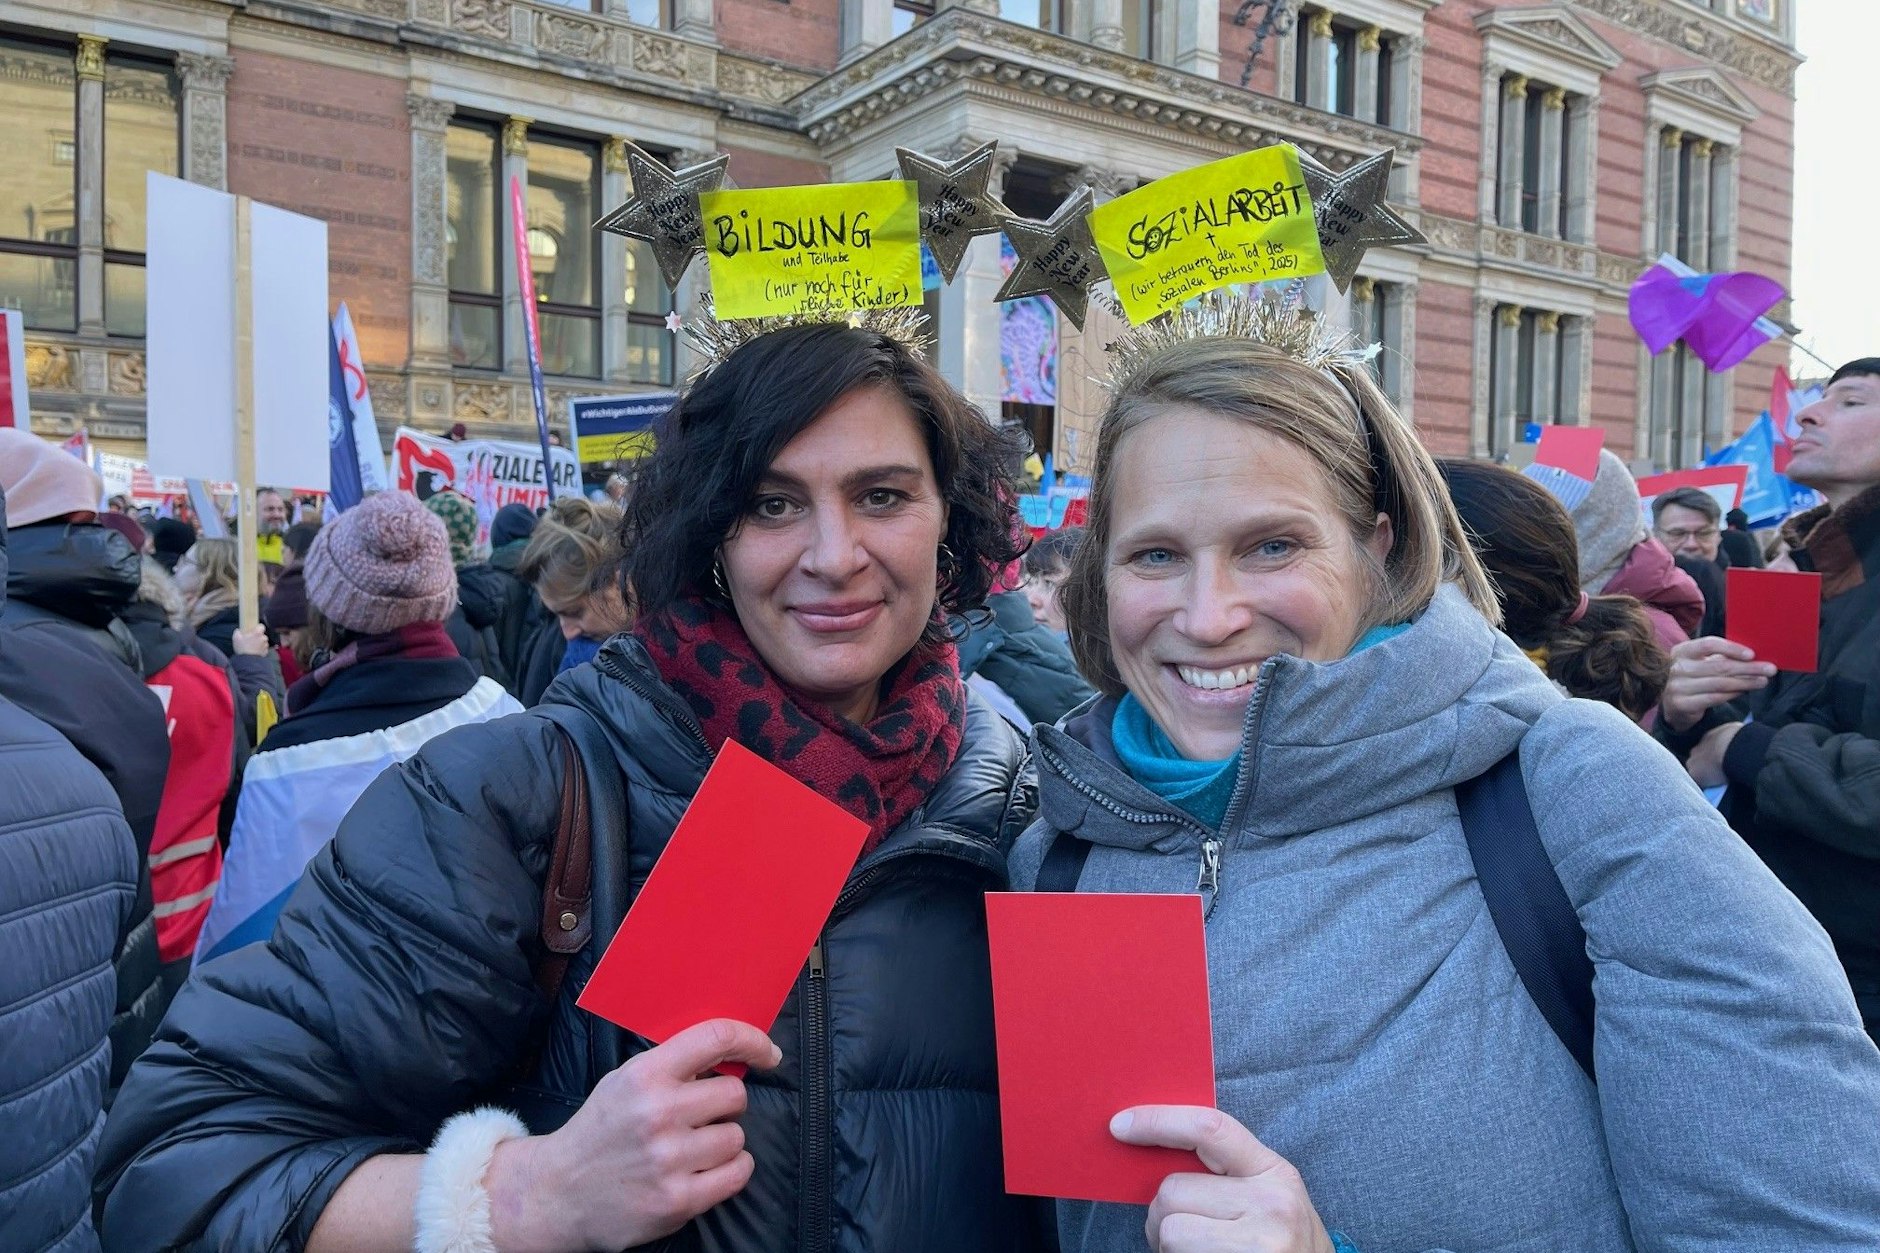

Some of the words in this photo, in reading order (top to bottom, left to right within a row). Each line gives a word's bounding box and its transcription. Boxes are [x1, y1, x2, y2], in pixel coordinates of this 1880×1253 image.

[645, 191, 689, 220] Happy
[934, 199, 966, 227] New
[939, 183, 979, 217] Happy
[1325, 189, 1368, 223] Happy
[658, 210, 695, 235] New
[921, 215, 954, 238] Year
[667, 226, 704, 249] Year
[1318, 231, 1339, 247] ear
[783, 252, 802, 267] und
[807, 252, 850, 266] Teilhabe
[1032, 235, 1071, 274] Happy
[1050, 251, 1081, 282] New
[1269, 254, 1298, 271] 2025)
[1061, 262, 1091, 288] Year
[1131, 280, 1155, 301] (wir
[1158, 256, 1213, 284] betrauern
[1217, 247, 1236, 262] den
[1238, 243, 1260, 259] Tod
[1266, 240, 1284, 255] des
[765, 279, 798, 302] (nur
[805, 273, 836, 296] noch
[840, 269, 873, 298] für
[852, 283, 909, 309] Kinder)
